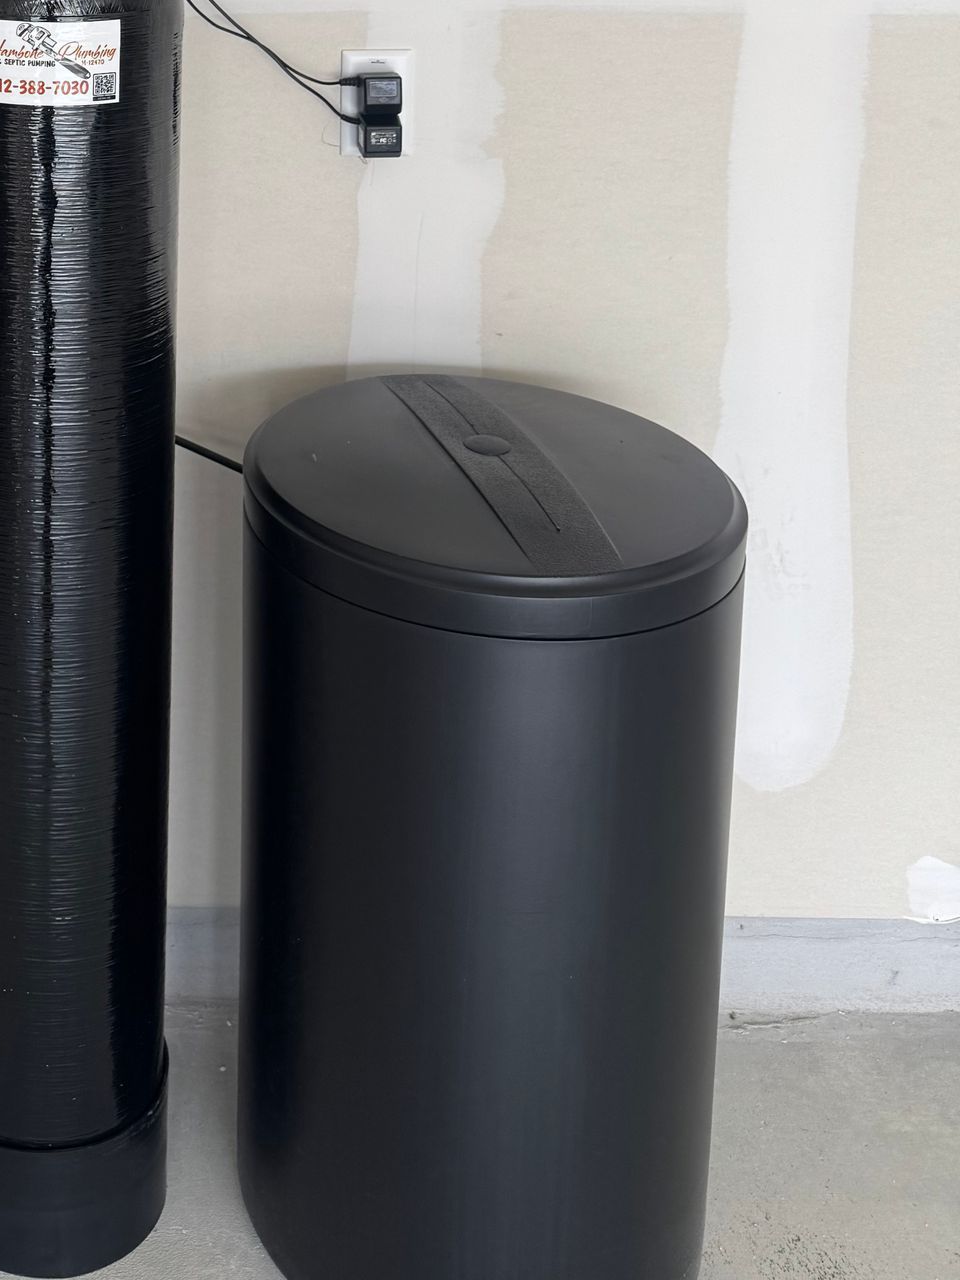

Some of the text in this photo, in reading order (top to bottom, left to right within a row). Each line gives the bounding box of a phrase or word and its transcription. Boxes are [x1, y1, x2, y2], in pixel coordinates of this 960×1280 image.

[58, 41, 117, 61] Plumbing
[4, 58, 26, 66] SEPTIC
[28, 59, 56, 68] PUMPING
